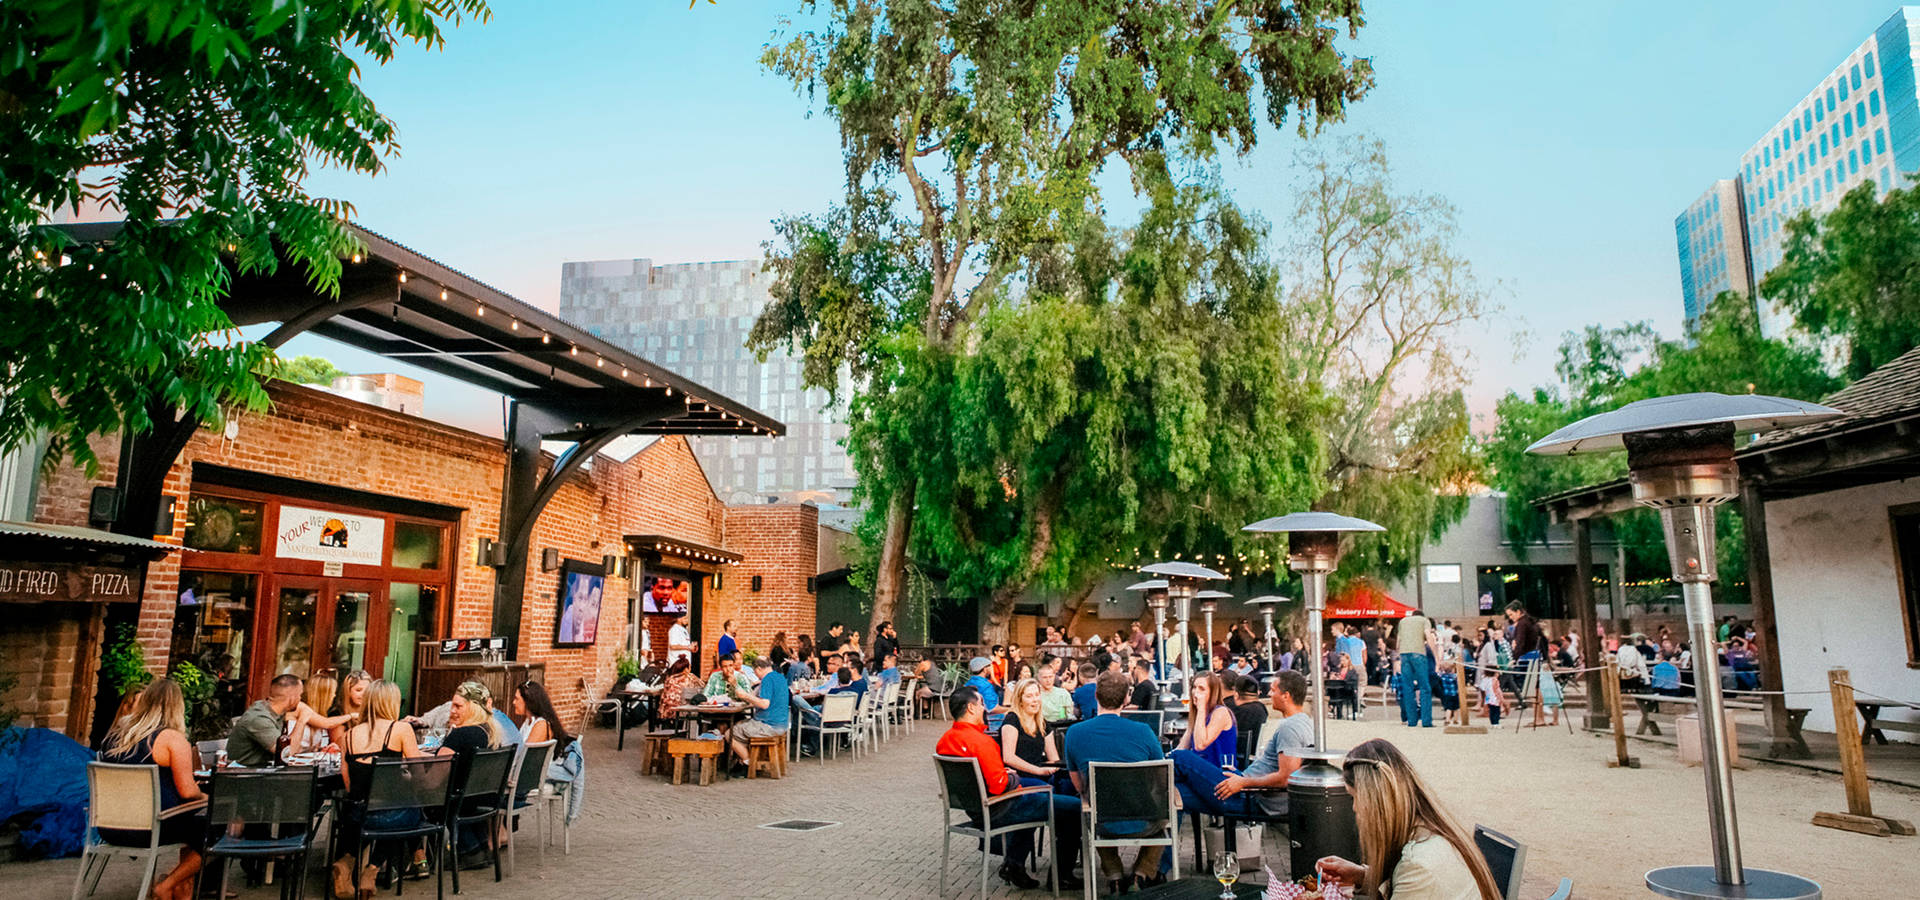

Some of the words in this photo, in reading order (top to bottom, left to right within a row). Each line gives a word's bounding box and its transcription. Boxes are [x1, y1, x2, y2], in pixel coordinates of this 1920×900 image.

[280, 521, 310, 544] YOUR
[309, 515, 349, 527] WELE
[351, 520, 361, 532] TO
[16, 569, 58, 595] FIRED
[92, 573, 130, 595] PIZZA
[1335, 608, 1361, 616] history
